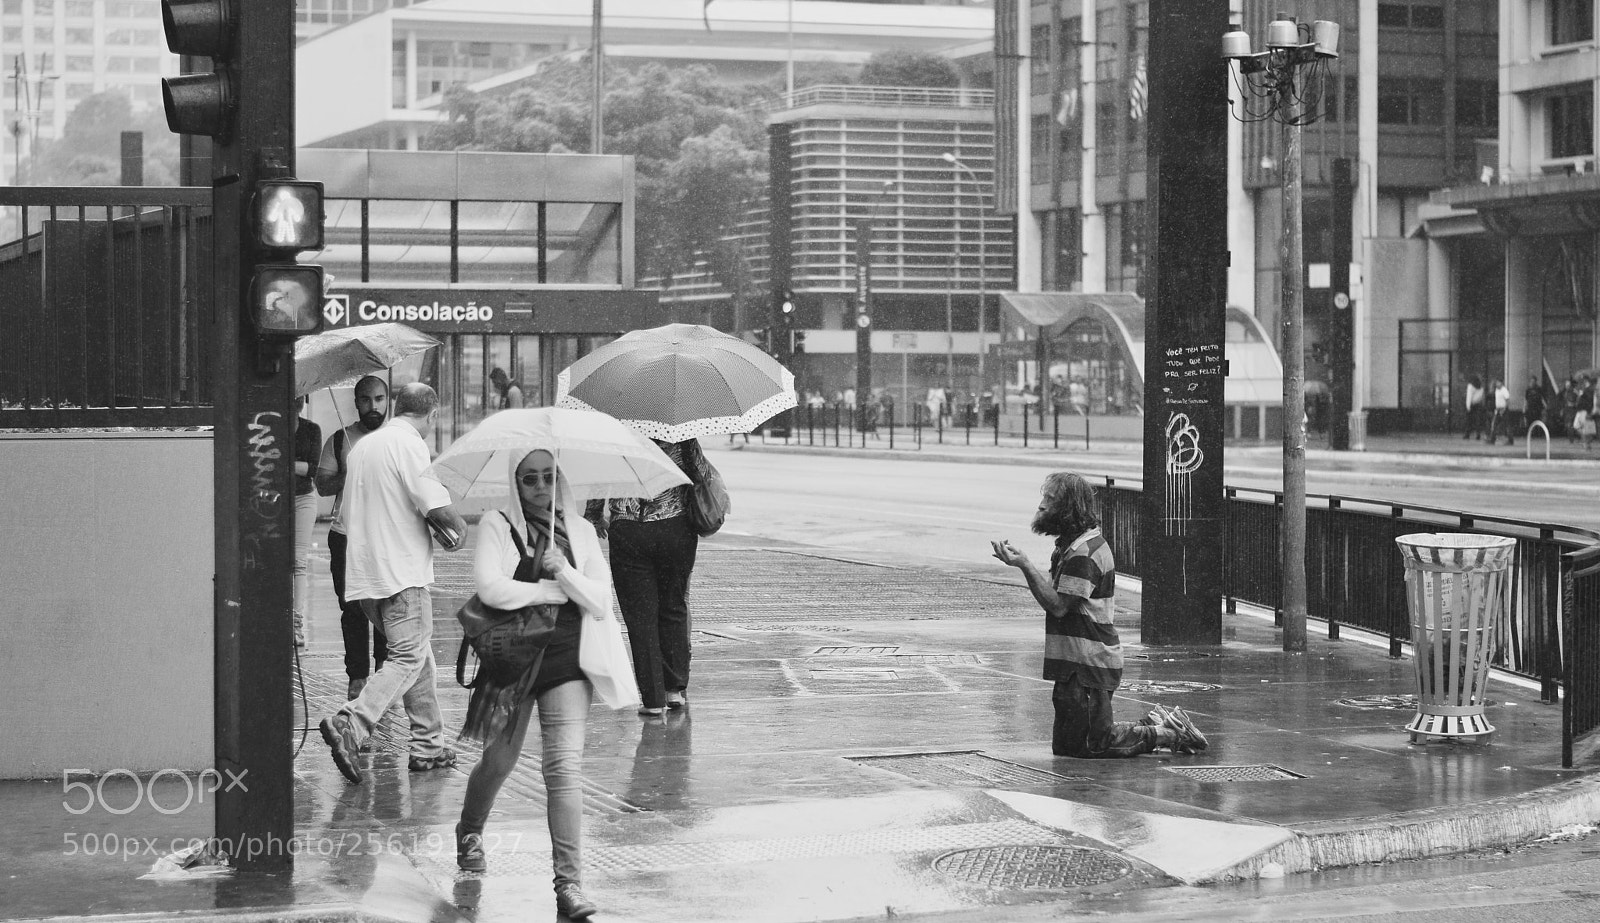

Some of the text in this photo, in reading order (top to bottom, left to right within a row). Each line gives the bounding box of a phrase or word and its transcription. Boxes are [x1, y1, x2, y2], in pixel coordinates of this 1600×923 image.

[358, 300, 494, 324] Consolação
[1185, 346, 1199, 354] TEM
[1200, 344, 1219, 352] FEITO
